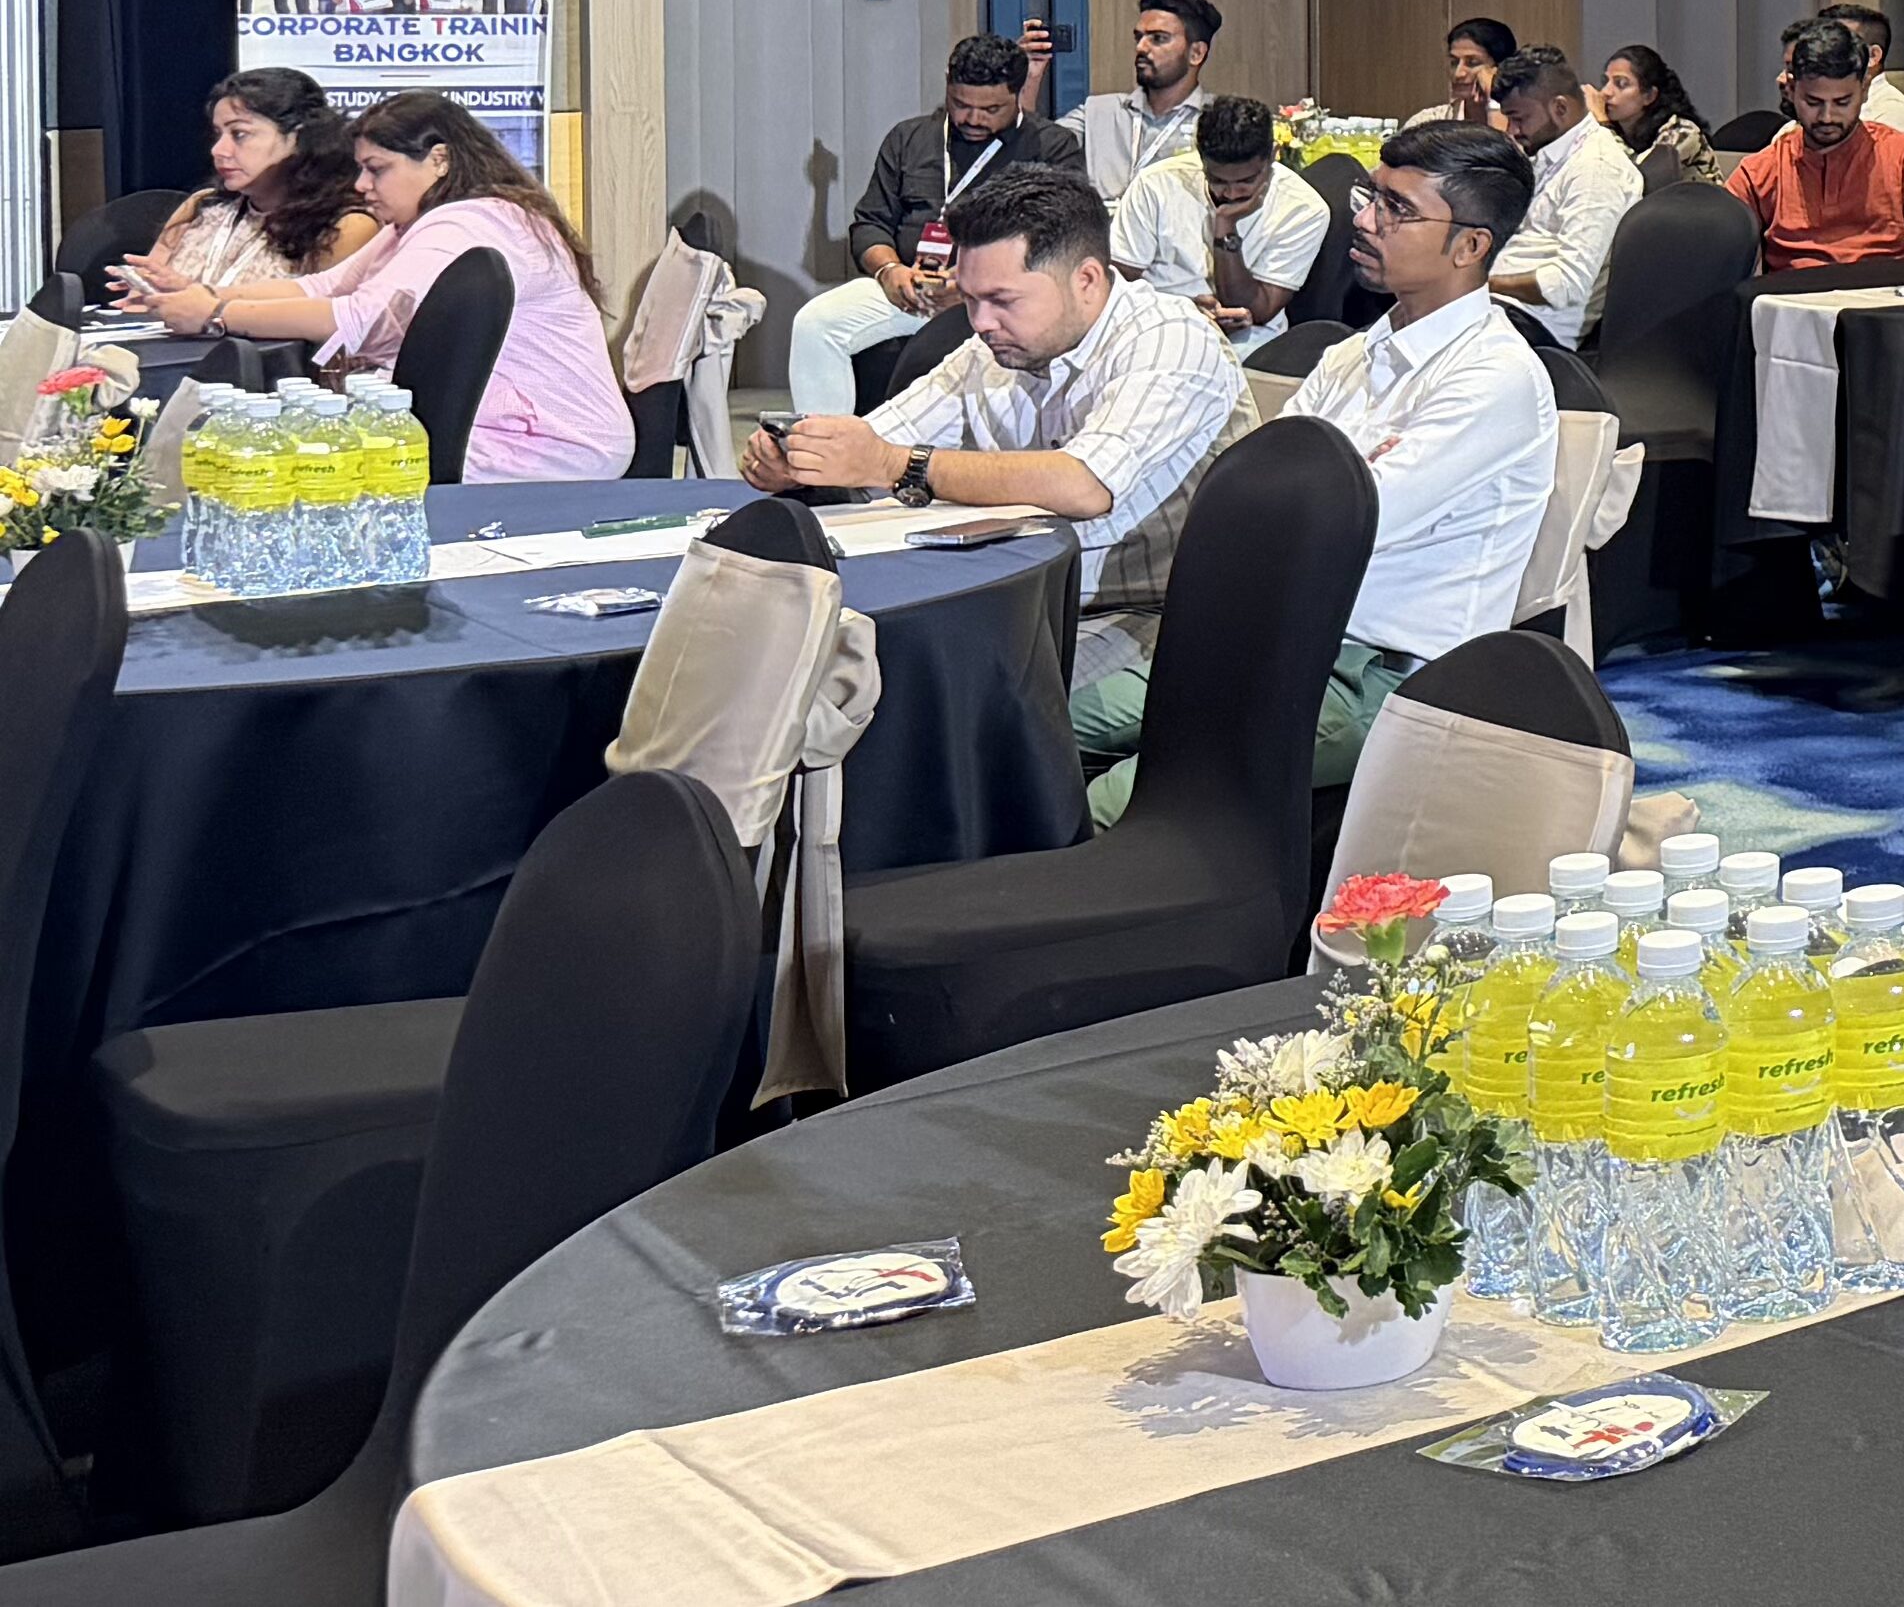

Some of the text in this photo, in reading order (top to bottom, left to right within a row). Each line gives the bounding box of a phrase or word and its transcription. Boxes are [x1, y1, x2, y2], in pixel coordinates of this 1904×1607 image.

[431, 16, 547, 36] TRAININ
[333, 43, 485, 63] BANGKOK
[1758, 1047, 1834, 1079] refresh
[1651, 1072, 1726, 1102] refresh
